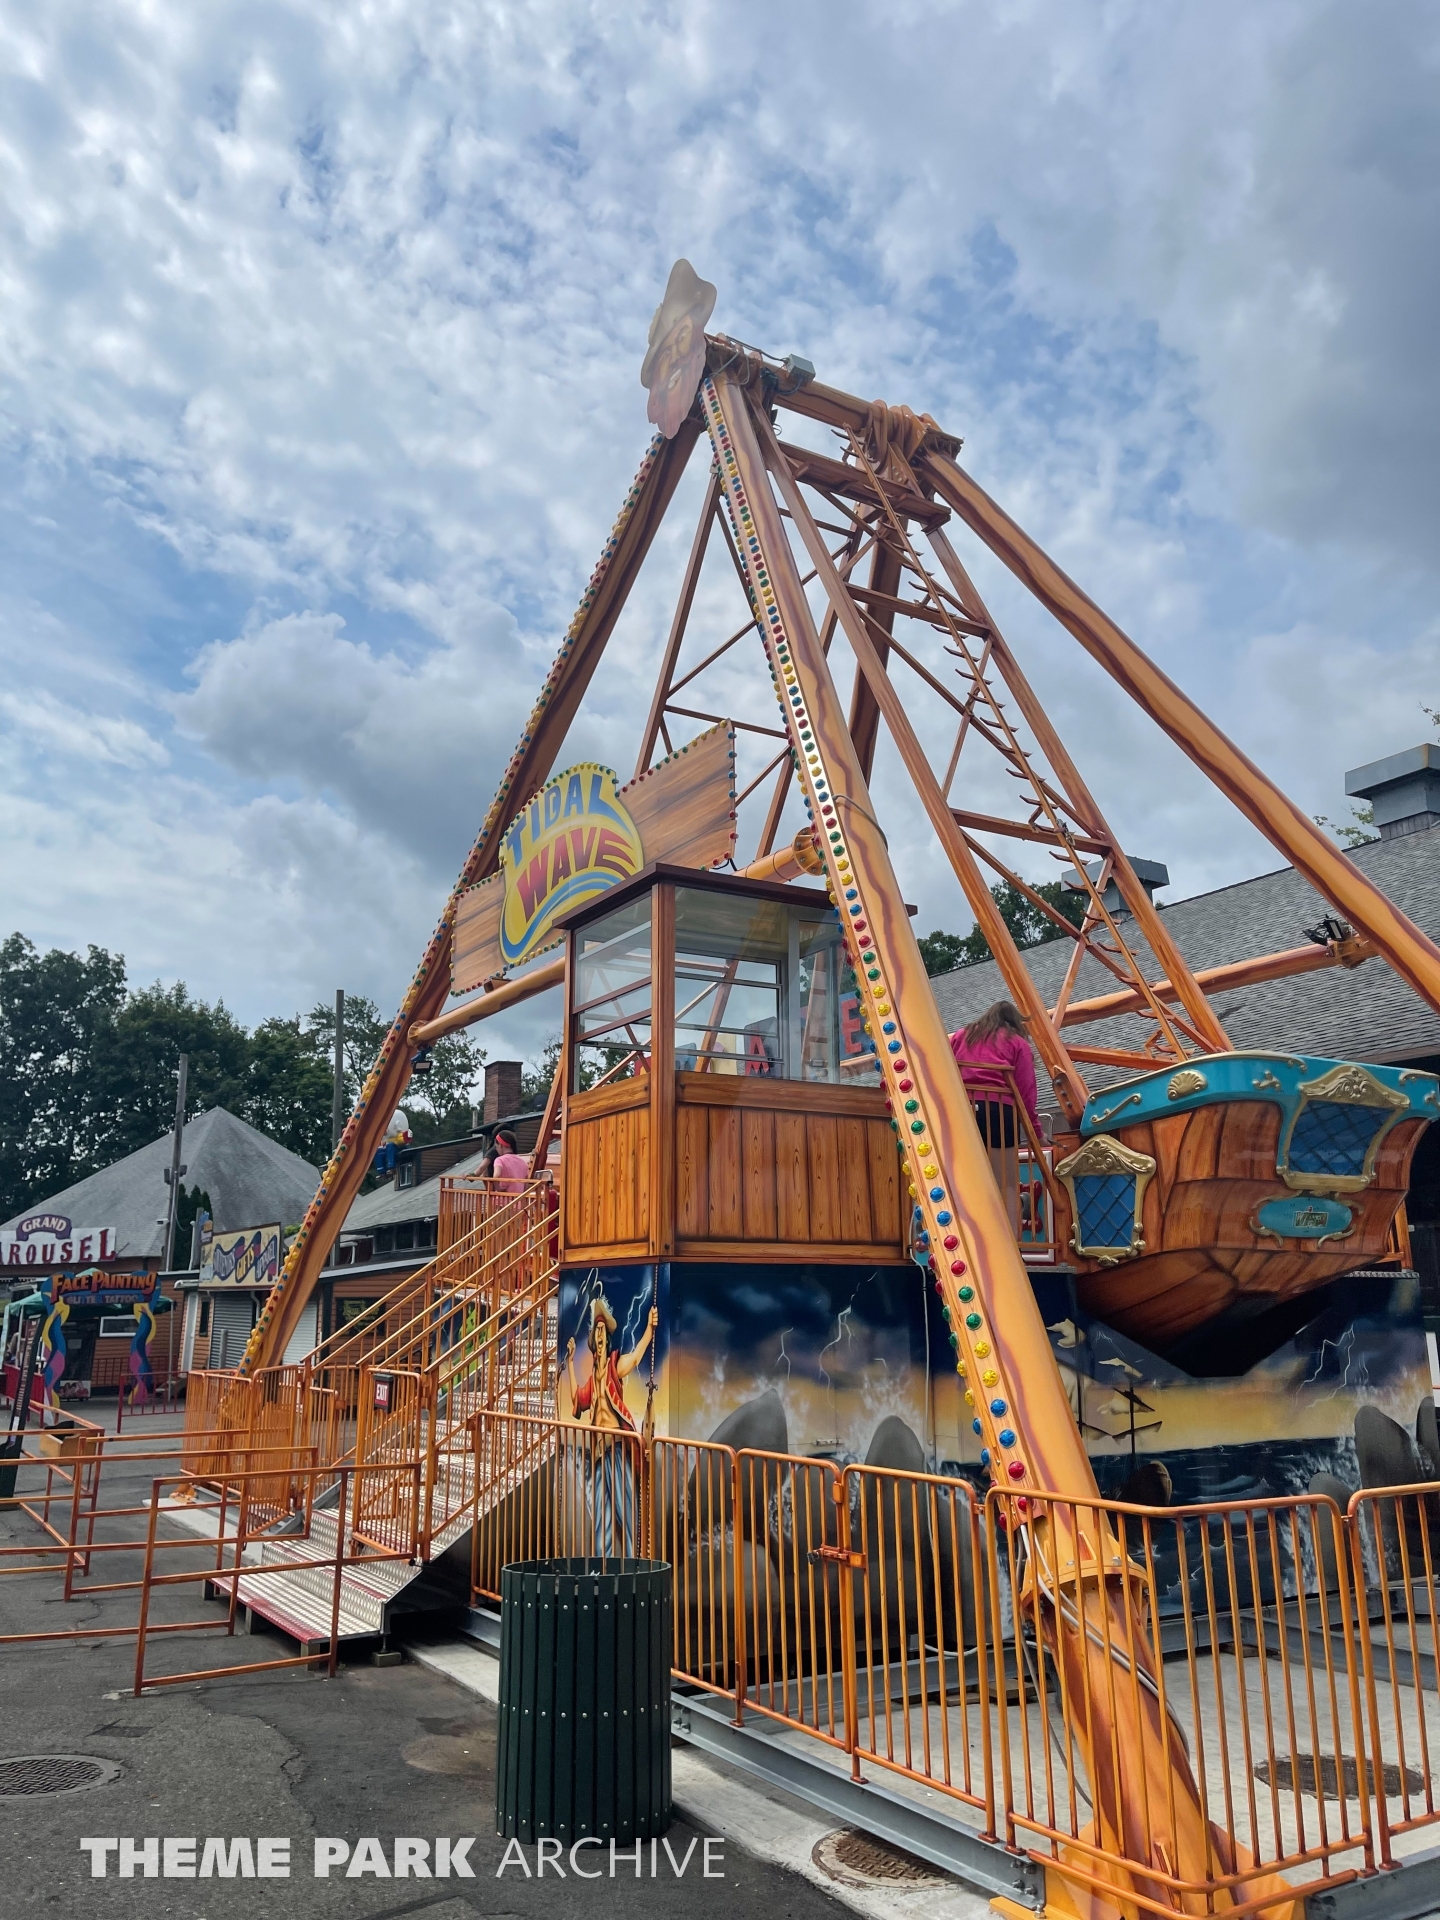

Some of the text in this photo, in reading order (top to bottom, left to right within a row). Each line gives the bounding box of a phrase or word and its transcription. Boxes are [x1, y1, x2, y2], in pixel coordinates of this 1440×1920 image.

[506, 773, 634, 869] TIDAL
[516, 827, 637, 924] WAVE
[22, 1216, 67, 1232] GRAND
[50, 1274, 90, 1304] FACE
[375, 1383, 388, 1402] EXIT
